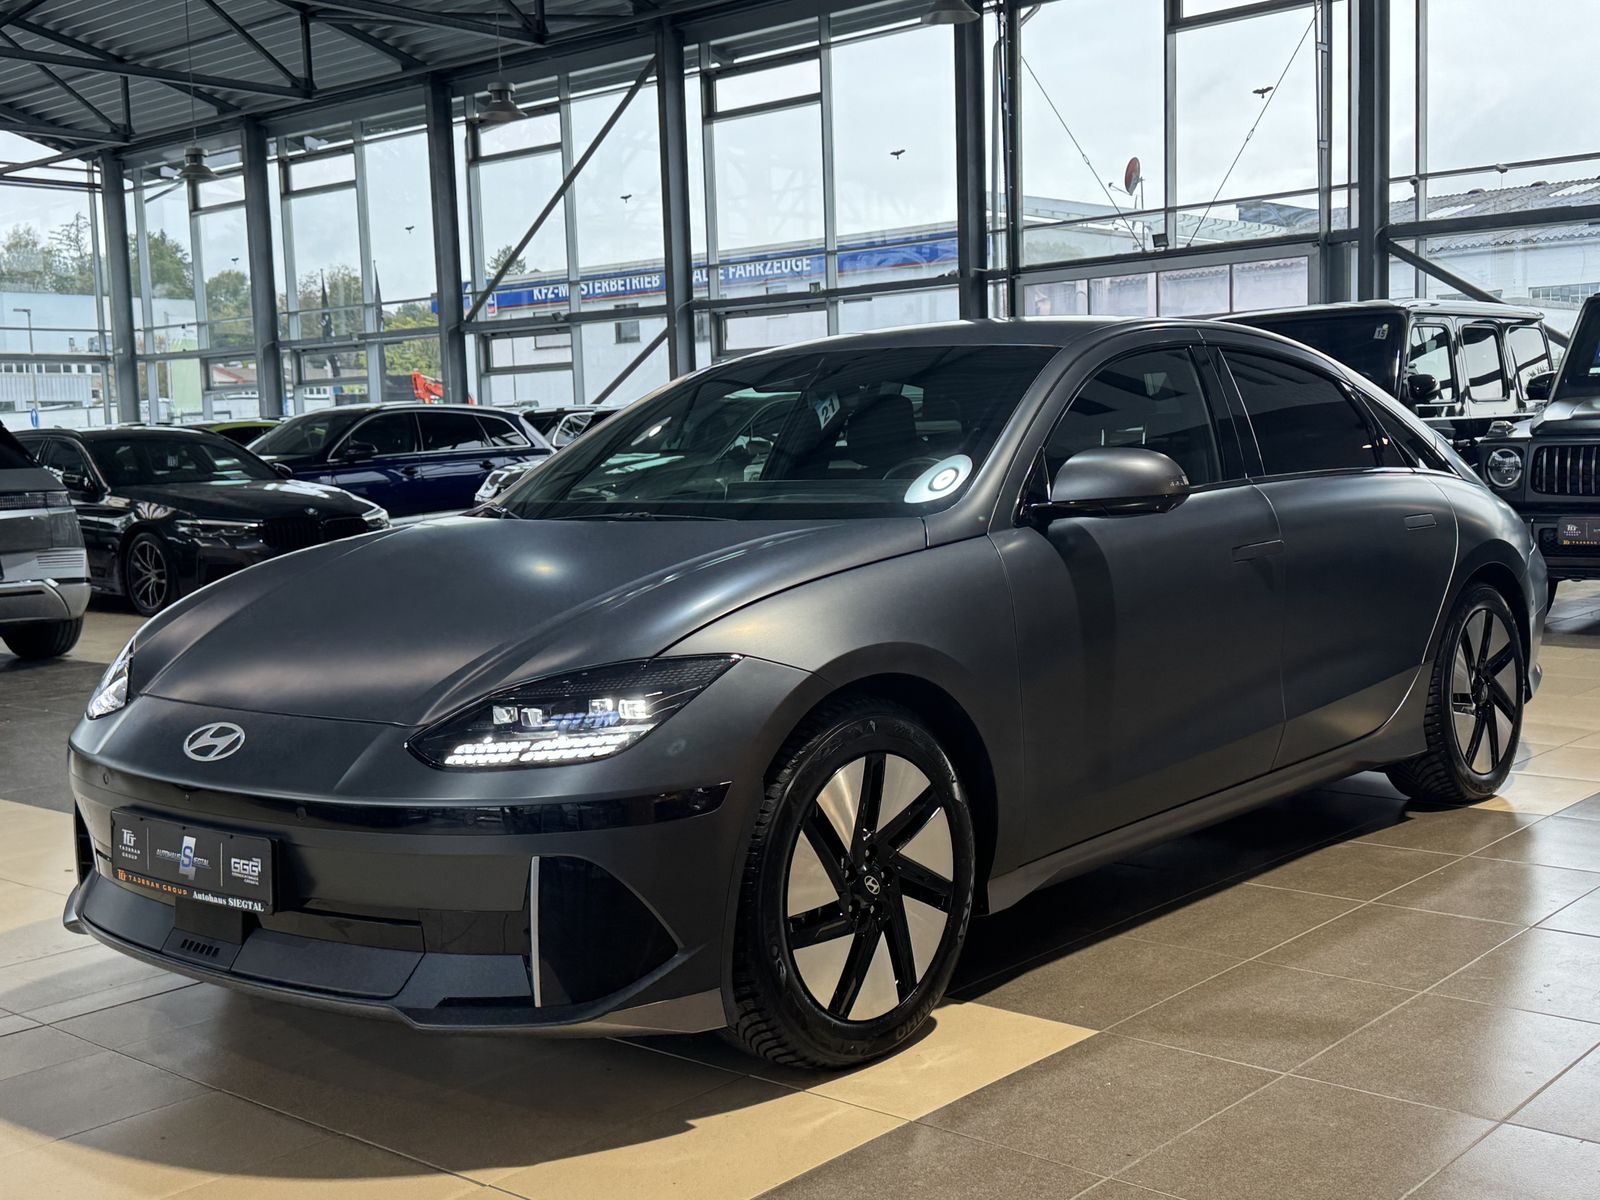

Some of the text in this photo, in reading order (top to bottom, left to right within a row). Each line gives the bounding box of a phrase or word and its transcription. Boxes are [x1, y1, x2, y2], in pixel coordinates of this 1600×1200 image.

[533, 257, 811, 301] KFZ-MSTERBETRIEB ALE FAHRZEUGE
[821, 398, 836, 425] 21
[162, 884, 188, 896] GROUP
[192, 890, 265, 913] Autohaus SIEGTAL
